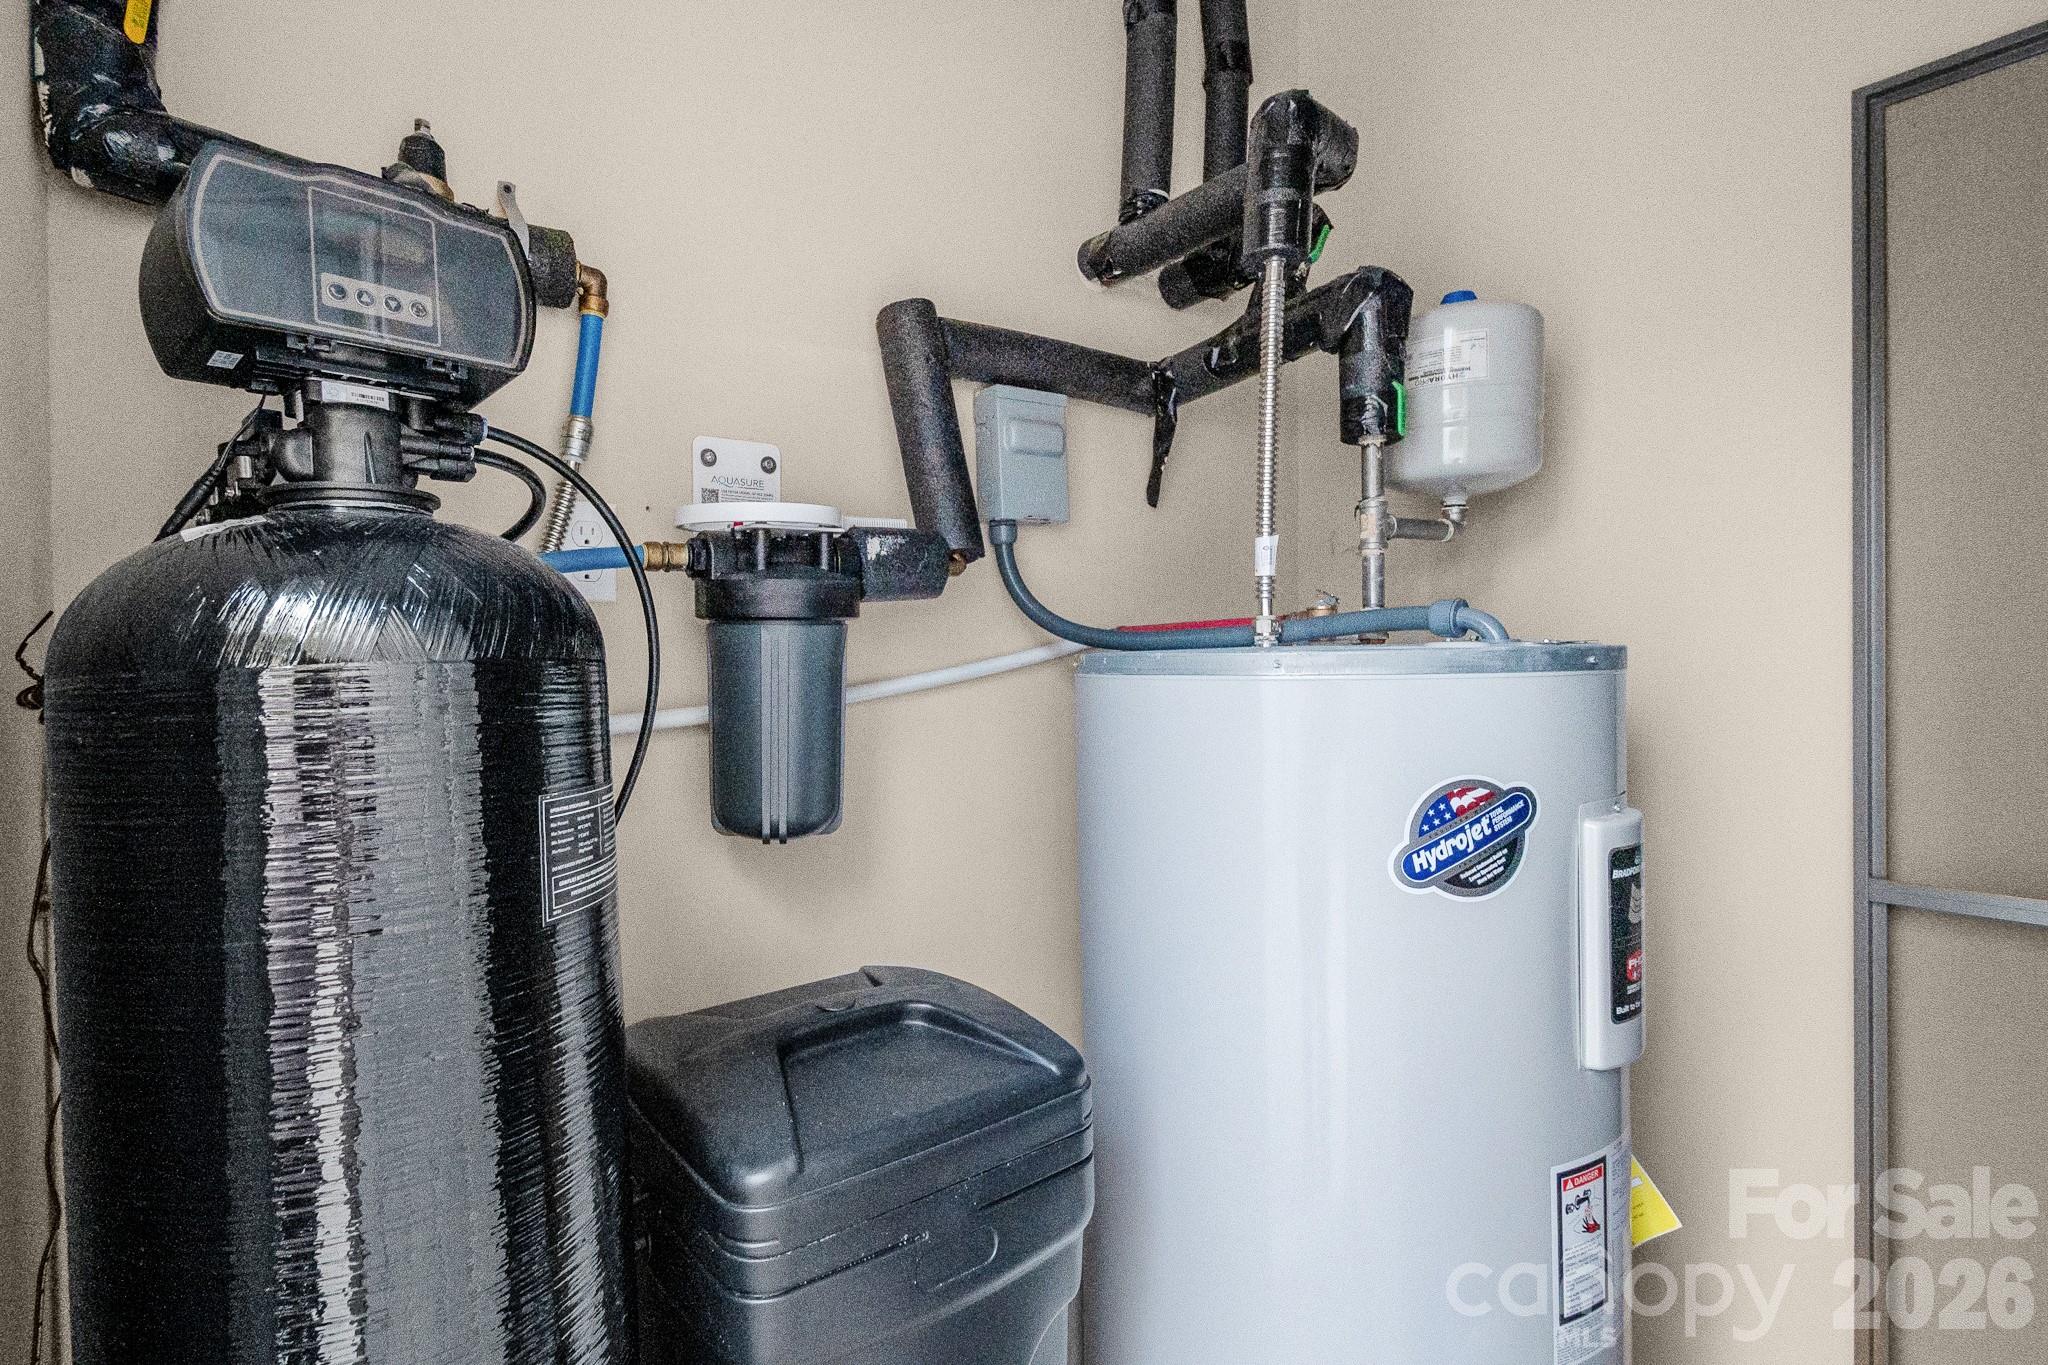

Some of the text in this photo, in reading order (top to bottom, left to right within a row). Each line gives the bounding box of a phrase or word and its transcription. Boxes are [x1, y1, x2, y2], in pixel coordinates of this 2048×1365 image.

[711, 475, 765, 488] AQUASURE
[1490, 805, 1504, 818] TOTAL
[1492, 799, 1525, 825] PERFORMANCE
[1494, 815, 1512, 831] SYSTEM
[1574, 1168, 1599, 1187] DANGER
